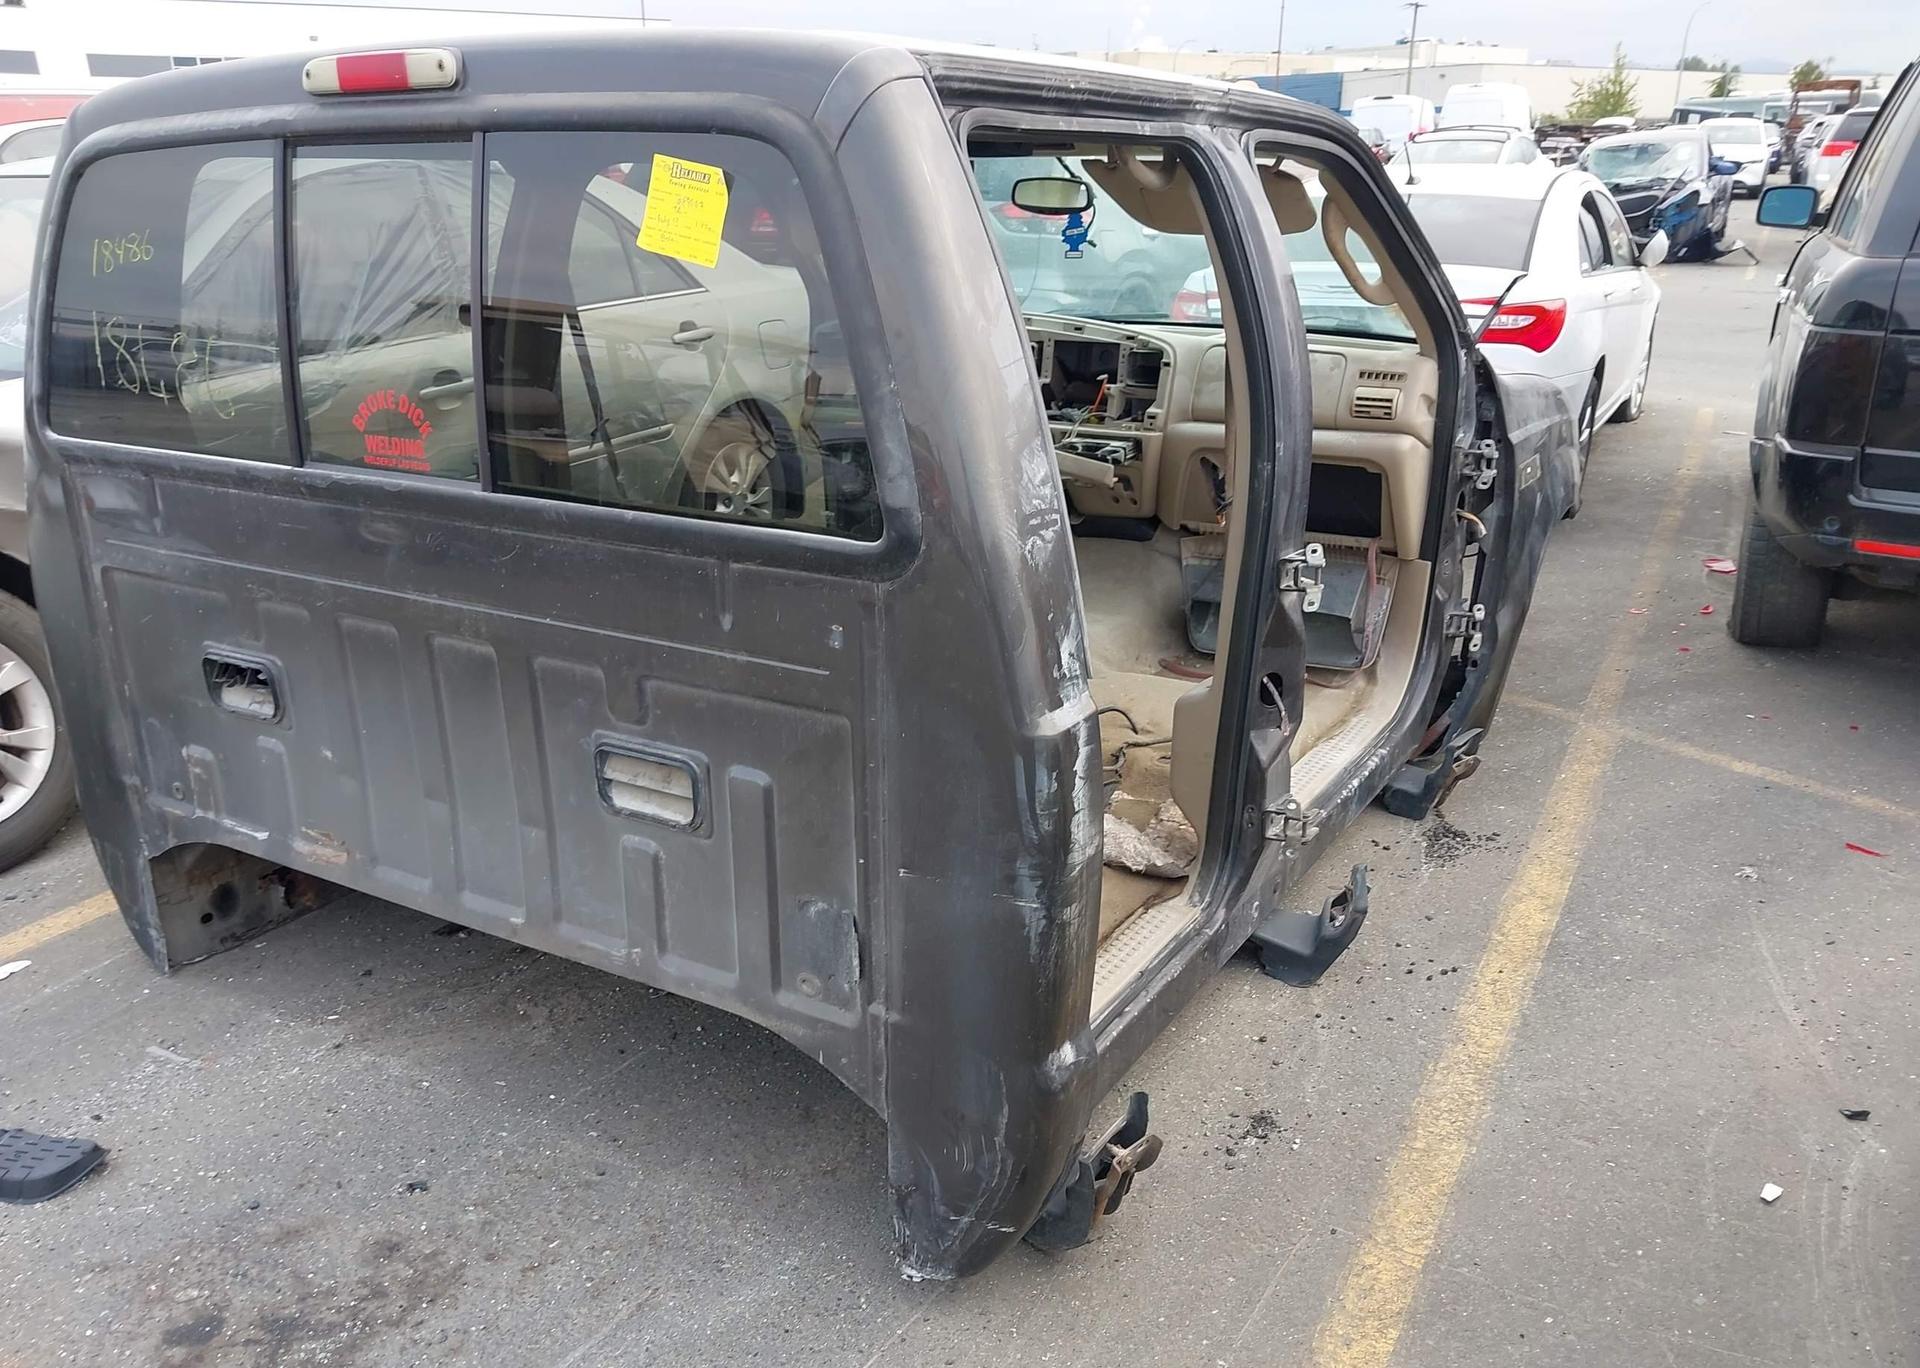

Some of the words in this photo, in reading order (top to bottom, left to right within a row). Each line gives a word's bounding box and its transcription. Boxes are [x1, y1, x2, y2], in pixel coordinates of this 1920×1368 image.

[671, 162, 712, 184] RELIABLE
[92, 229, 154, 277] 18486
[352, 389, 395, 433] BROKE
[364, 433, 426, 459] WELDING
